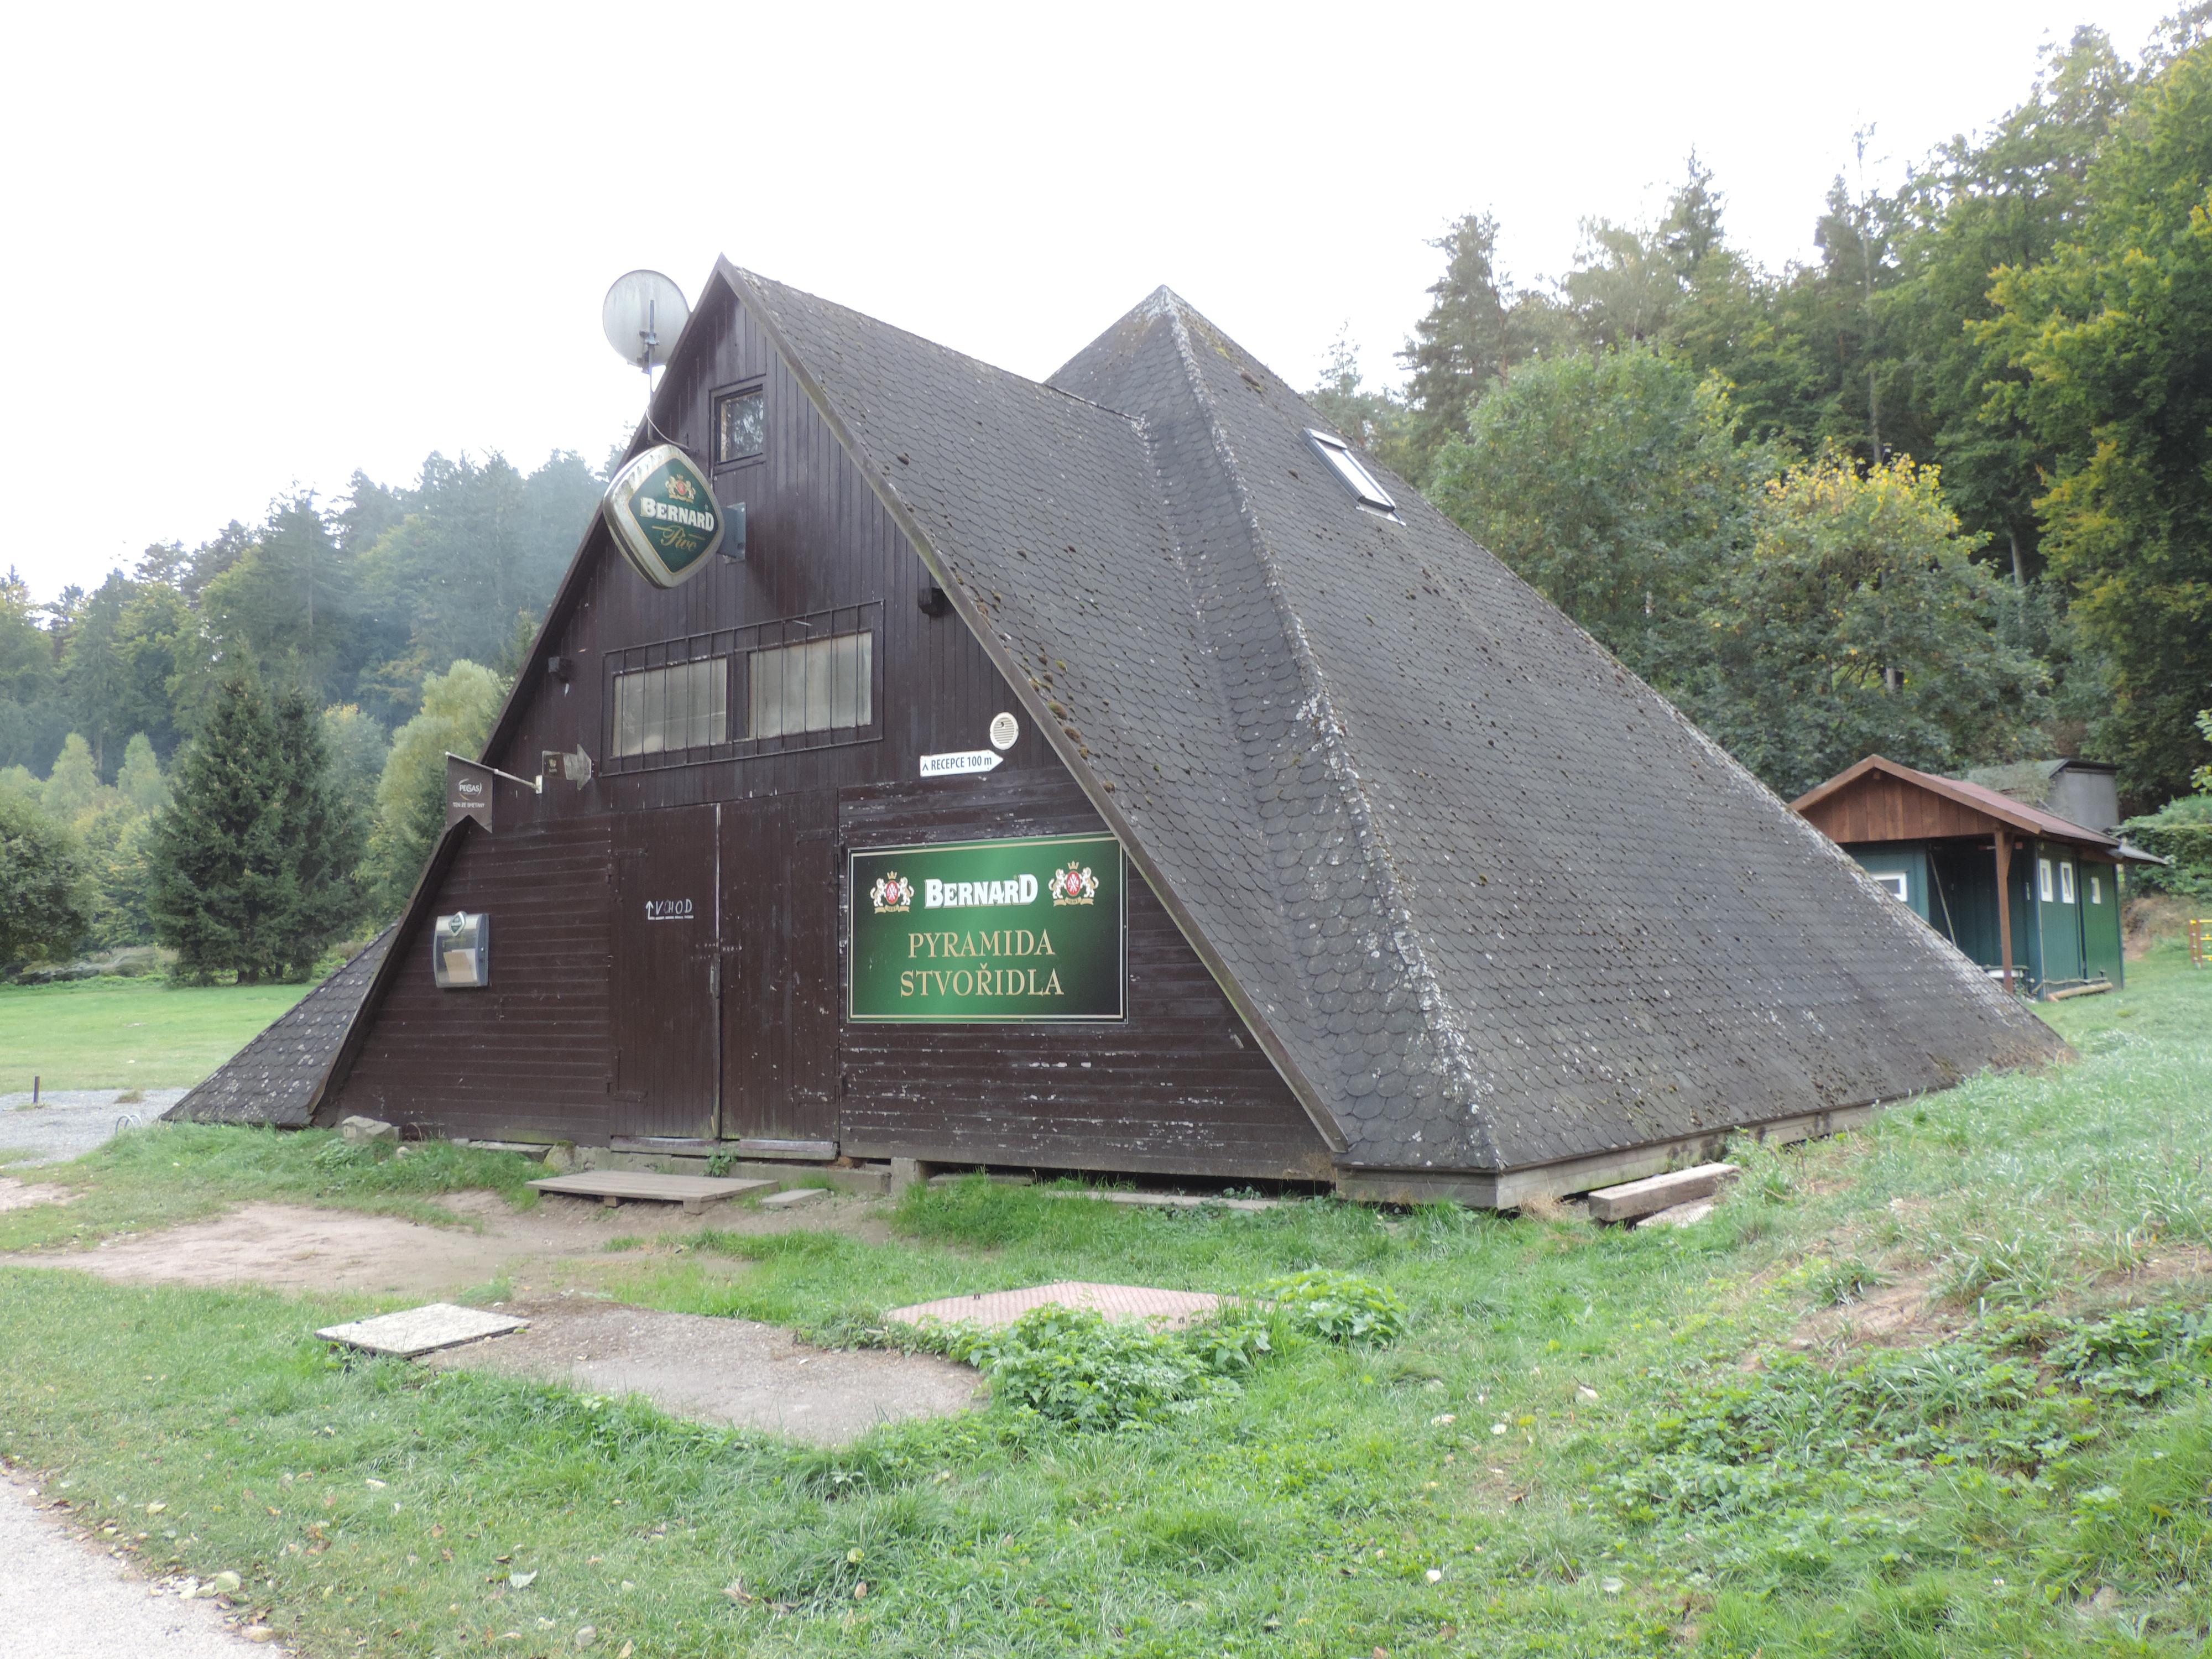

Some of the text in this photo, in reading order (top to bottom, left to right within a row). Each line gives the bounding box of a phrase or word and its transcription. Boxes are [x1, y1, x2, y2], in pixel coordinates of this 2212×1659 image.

[640, 497, 714, 531] BERNARD
[931, 755, 992, 771] RECEPCE 100 m
[460, 784, 479, 792] PEGAS
[925, 874, 1038, 909] BERNARD
[656, 899, 692, 915] VCHOD
[908, 928, 1055, 958] PYRAMIDA
[901, 963, 1064, 998] STVOŘIDLA
